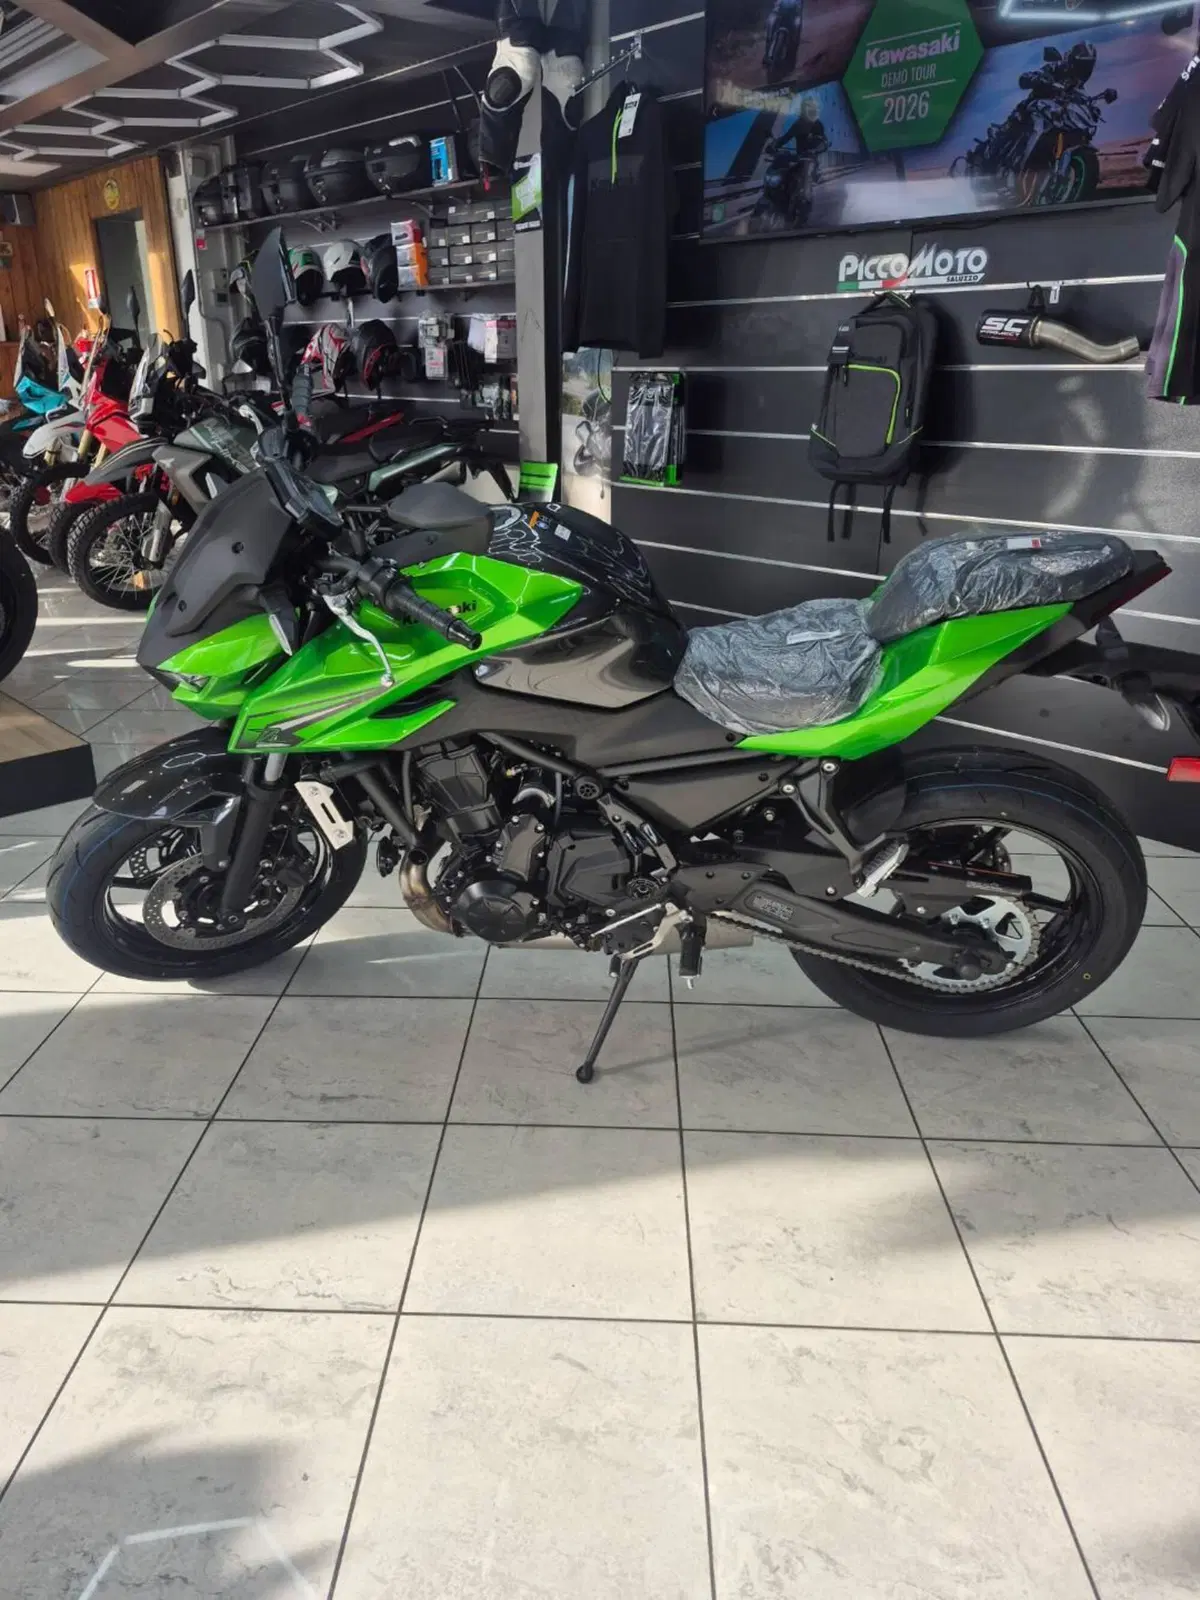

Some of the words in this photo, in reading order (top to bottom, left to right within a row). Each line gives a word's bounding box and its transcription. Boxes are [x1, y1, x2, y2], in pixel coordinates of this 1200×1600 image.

[865, 29, 960, 70] Kawasaki
[881, 69, 908, 89] DEMO
[911, 63, 937, 81] TOUR
[882, 91, 930, 125] 2026
[946, 274, 979, 283] SALUZZO
[981, 317, 1030, 333] SC
